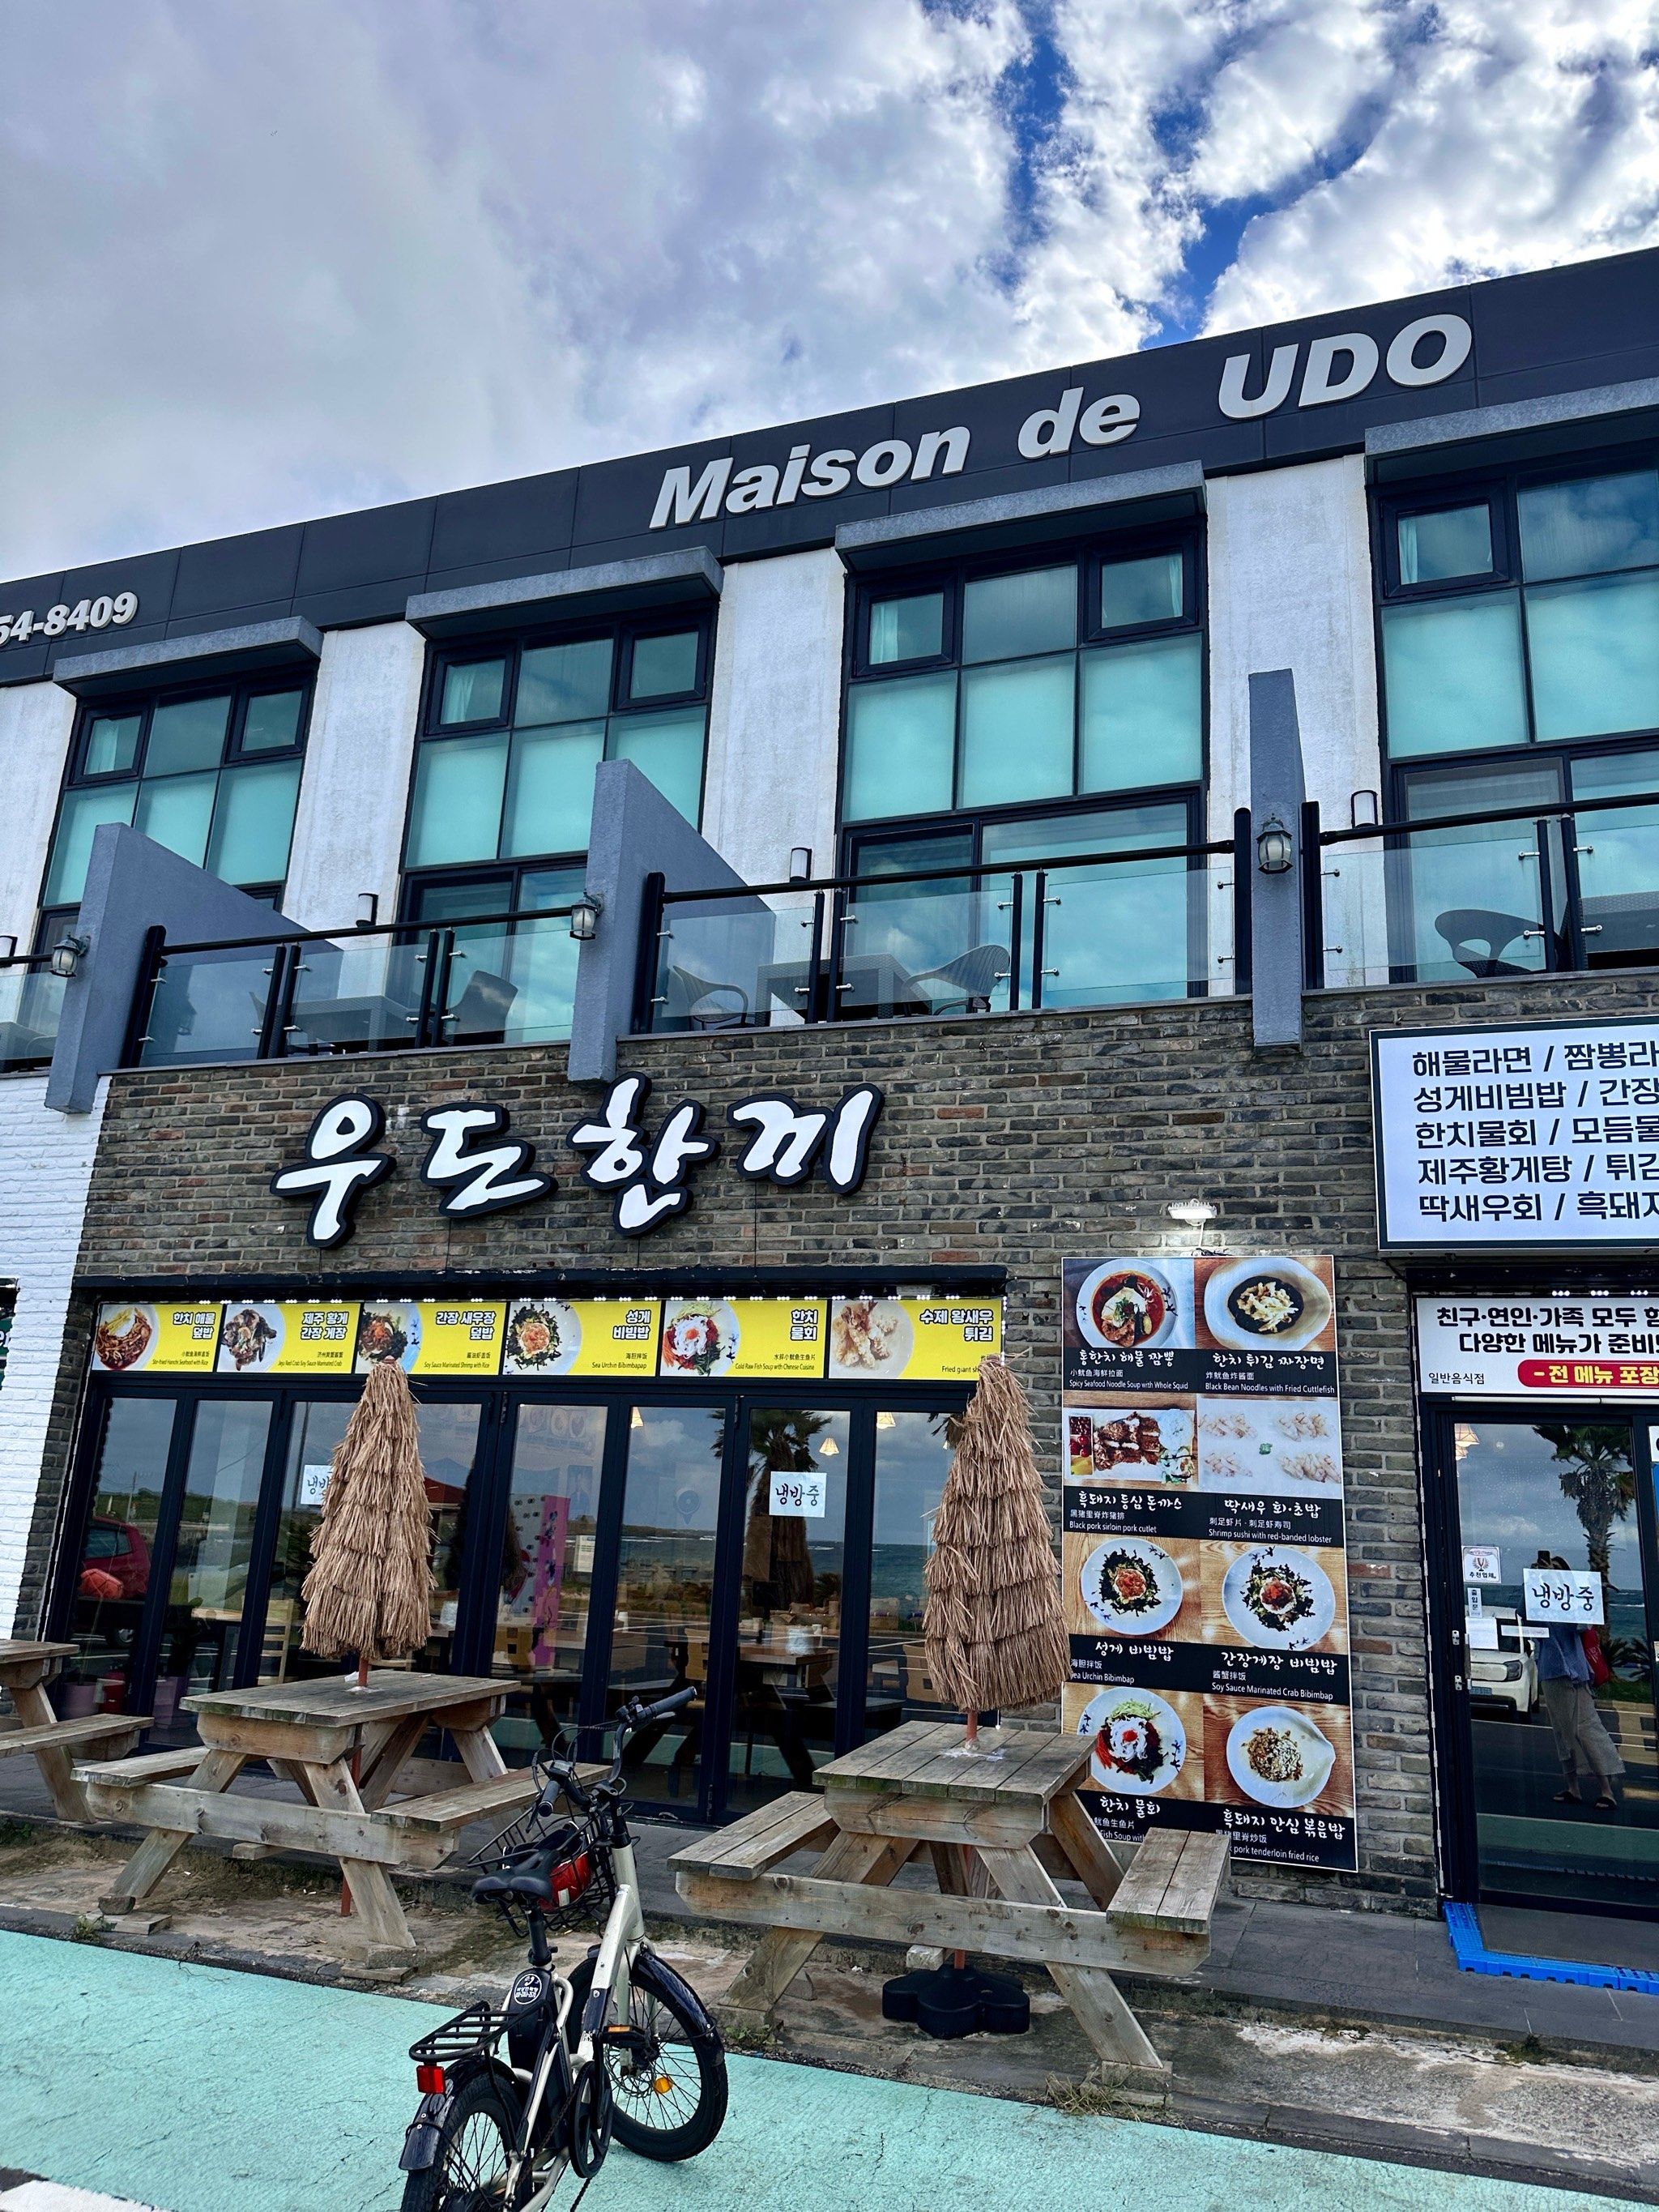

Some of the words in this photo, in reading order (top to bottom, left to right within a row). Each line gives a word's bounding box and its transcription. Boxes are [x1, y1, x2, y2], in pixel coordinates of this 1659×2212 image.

[649, 425, 970, 529] Maison
[1017, 387, 1141, 459] de
[1217, 313, 1473, 421] UDO
[1413, 1047, 1532, 1077] 해물라면
[1414, 1082, 1567, 1113] 성게비빔밥
[1415, 1119, 1537, 1150] 한치물회
[1418, 1155, 1573, 1185] 제주황게탕
[1419, 1193, 1542, 1222] 딱새우회
[173, 1312, 193, 1325] 한치
[194, 1312, 215, 1325] 해물
[303, 1312, 324, 1325] 제주
[326, 1312, 349, 1325] 황게
[436, 1311, 458, 1325] 간장
[461, 1311, 496, 1325] 새우장
[626, 1310, 650, 1324] 성게
[791, 1309, 818, 1325] 한치
[919, 1309, 947, 1324] 수제
[951, 1309, 994, 1325] 왕새우
[1436, 1307, 1584, 1328] 친구·연인·가족
[1592, 1307, 1637, 1327] 모두
[192, 1326, 213, 1339] 덮밥
[301, 1326, 322, 1339] 간장
[323, 1326, 346, 1339] 게장
[470, 1326, 493, 1340] 덮밥
[612, 1326, 650, 1339] 비빔밥
[791, 1326, 817, 1341] 물회
[964, 1326, 993, 1342] 튀김
[1459, 1333, 1526, 1353] 다양한
[1533, 1333, 1601, 1354] 메뉴가
[1608, 1334, 1659, 1354] 준비
[1079, 1349, 1116, 1366] 통한치
[1120, 1351, 1144, 1367] 해물
[1148, 1351, 1175, 1367] 짬뽕
[1213, 1352, 1242, 1368] 한치
[1246, 1354, 1274, 1369] 튀김
[1278, 1356, 1325, 1370] 짜장면
[957, 1366, 971, 1374] giant
[1548, 1365, 1569, 1384] 전
[1574, 1365, 1614, 1385] 메뉴
[1619, 1366, 1659, 1385] 포장
[1069, 1379, 1083, 1389] Spicy
[1084, 1380, 1106, 1388] Seafood
[1127, 1381, 1141, 1390] Soup
[1141, 1381, 1154, 1389] with
[1154, 1381, 1172, 1390] Whole
[1172, 1381, 1188, 1390] Squid
[1428, 1372, 1485, 1385] 일반음식점
[1205, 1382, 1222, 1390] Black
[1241, 1383, 1269, 1392] Noodles
[1269, 1384, 1284, 1392] with
[1303, 1385, 1335, 1394] Cuttlefish
[775, 1483, 820, 1506] 냉방중
[1079, 1491, 1116, 1508] 흑돼지
[1120, 1493, 1143, 1510] 등심
[1147, 1495, 1182, 1511] 돈까스
[1224, 1499, 1265, 1515] 딱새우
[1069, 1521, 1085, 1529] Black
[1087, 1522, 1102, 1531] pork
[1123, 1524, 1137, 1532] pork
[1138, 1525, 1157, 1533] cutlet
[1209, 1528, 1232, 1538] Shrimp
[1234, 1530, 1251, 1538] sushi
[1252, 1531, 1266, 1539] with
[1267, 1532, 1307, 1541] red-banded
[1307, 1534, 1332, 1543] lobster
[1532, 1582, 1594, 1611] 냉방중
[1095, 1642, 1123, 1656] 성게
[1129, 1645, 1174, 1661] 비빔밥
[1221, 1651, 1284, 1670] 간장게장
[1290, 1658, 1337, 1675] 비빔밥
[1081, 1672, 1102, 1680] Urchin
[1104, 1674, 1134, 1685] Bibimbap
[1212, 1682, 1224, 1693] Soy
[1226, 1684, 1245, 1693] Sauce
[1247, 1685, 1281, 1695] Marinated
[1282, 1688, 1299, 1697] Crab
[1300, 1689, 1333, 1702] Bibimbap
[1100, 1796, 1128, 1813] 한치
[1136, 1799, 1160, 1818] 물회
[1223, 1808, 1265, 1829] 흑돼지
[1270, 1817, 1299, 1834] 안심
[1304, 1818, 1346, 1840] 볶음밥
[1114, 1831, 1131, 1841] Soup
[1234, 1846, 1250, 1855] pork
[1251, 1847, 1287, 1858] tenderloin
[1288, 1850, 1305, 1860] fried
[1306, 1852, 1320, 1863] rice
